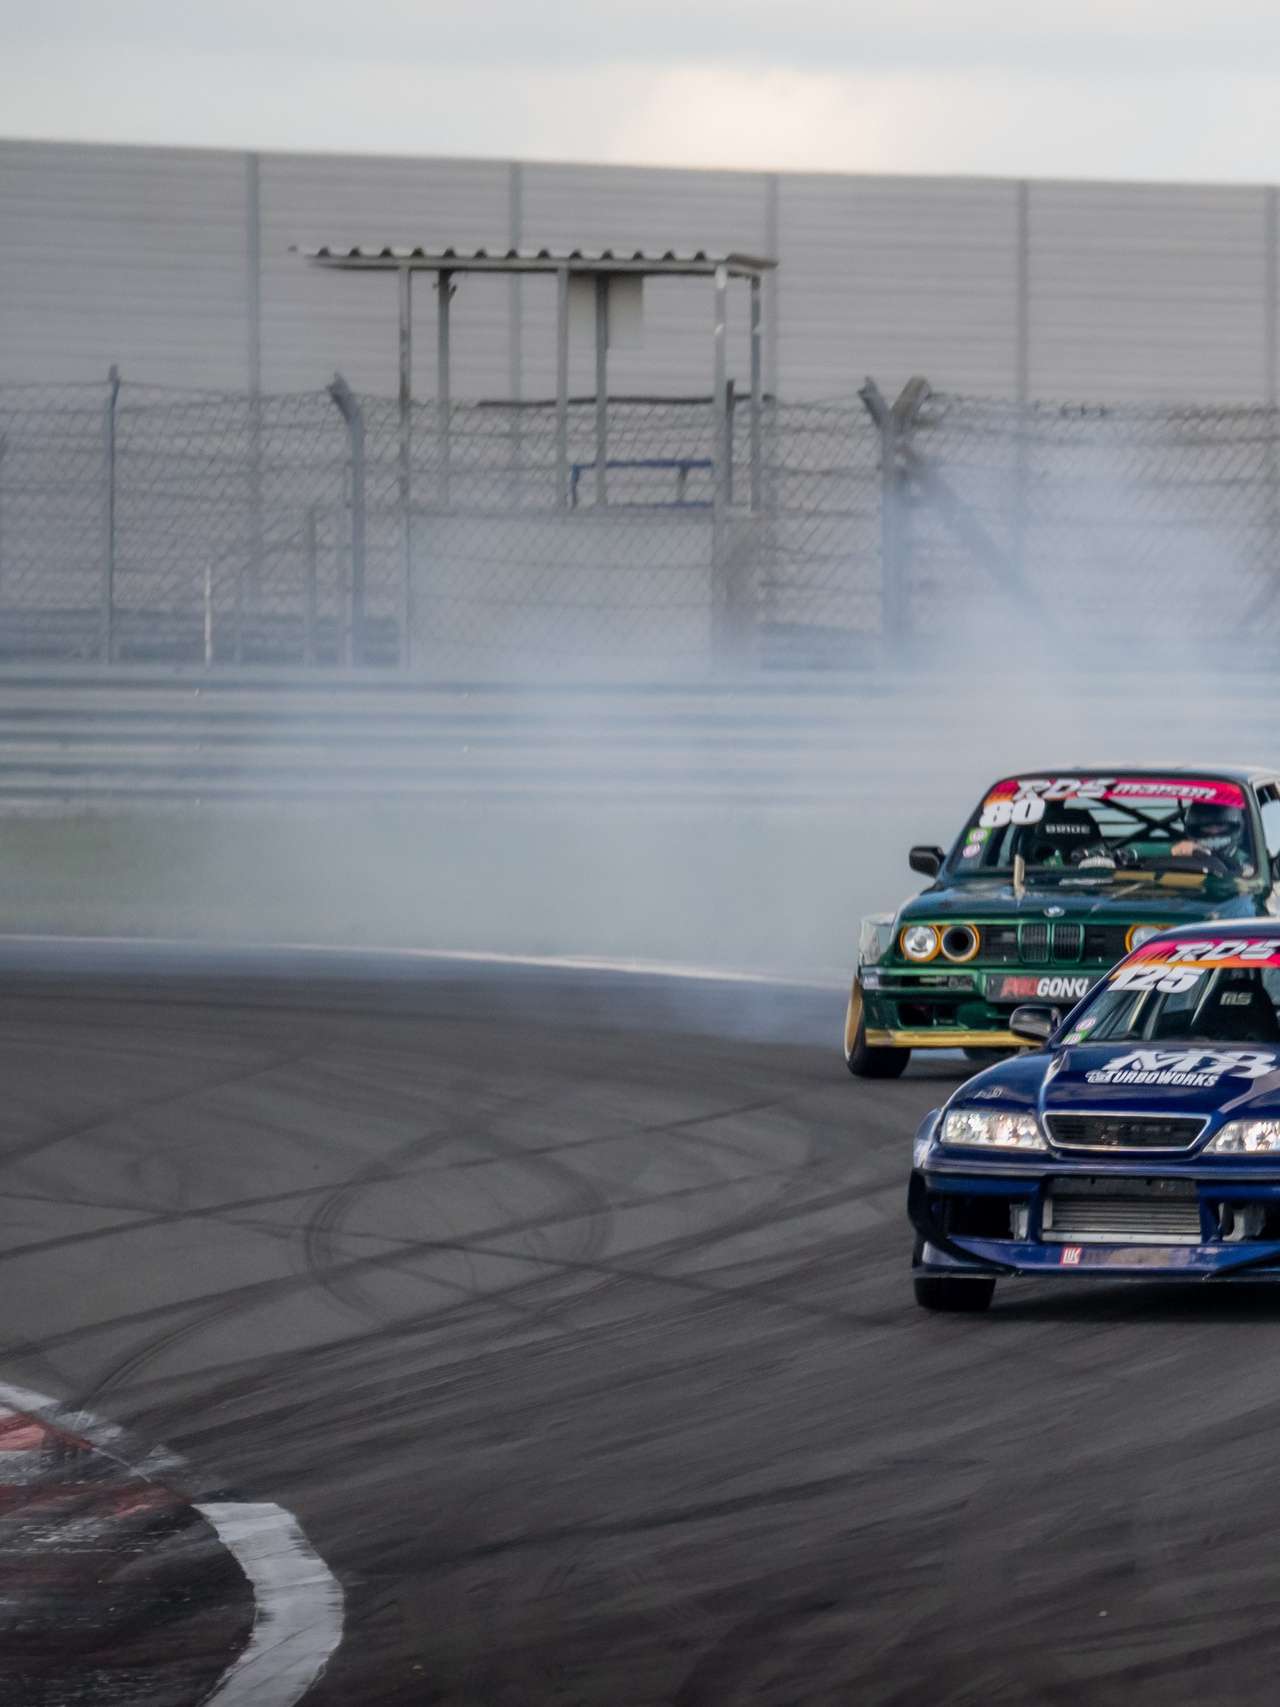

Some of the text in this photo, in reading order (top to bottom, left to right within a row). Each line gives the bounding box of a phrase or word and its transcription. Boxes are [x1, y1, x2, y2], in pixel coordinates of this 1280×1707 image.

[1013, 778, 1116, 800] RDS
[979, 799, 1046, 828] 80
[1106, 965, 1205, 993] 125
